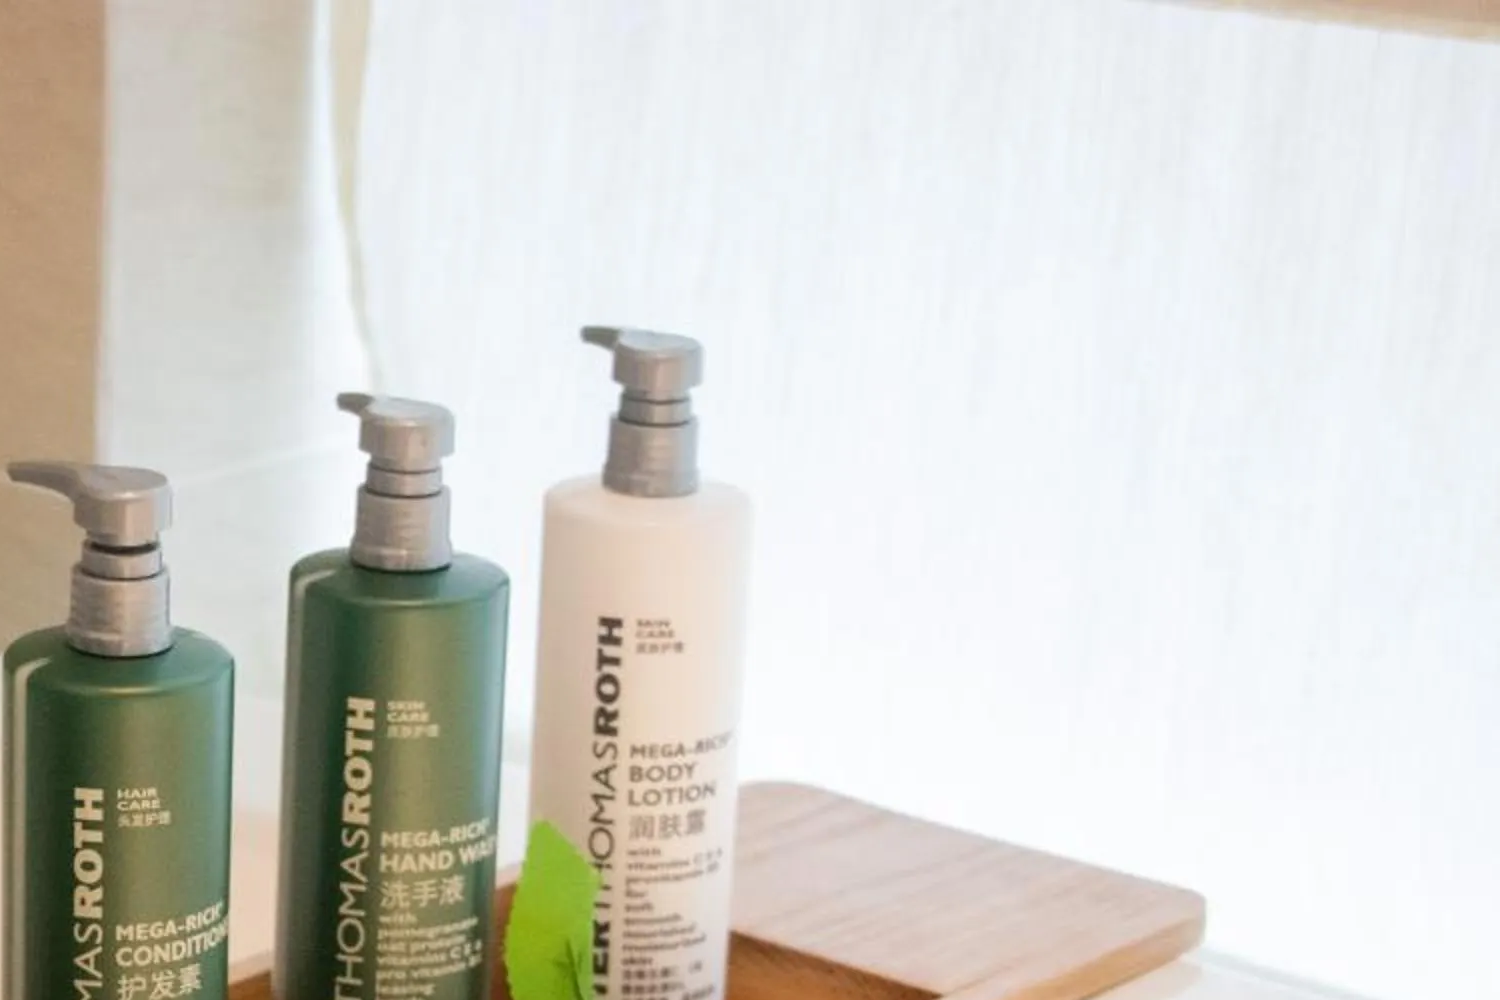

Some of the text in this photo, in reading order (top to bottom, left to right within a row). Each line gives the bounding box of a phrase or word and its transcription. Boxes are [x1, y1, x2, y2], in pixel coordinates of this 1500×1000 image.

[629, 761, 697, 783] BODY
[117, 787, 157, 799] HAIR
[628, 780, 716, 807] LOTION
[117, 798, 161, 811] CARE
[379, 850, 454, 874] HAND
